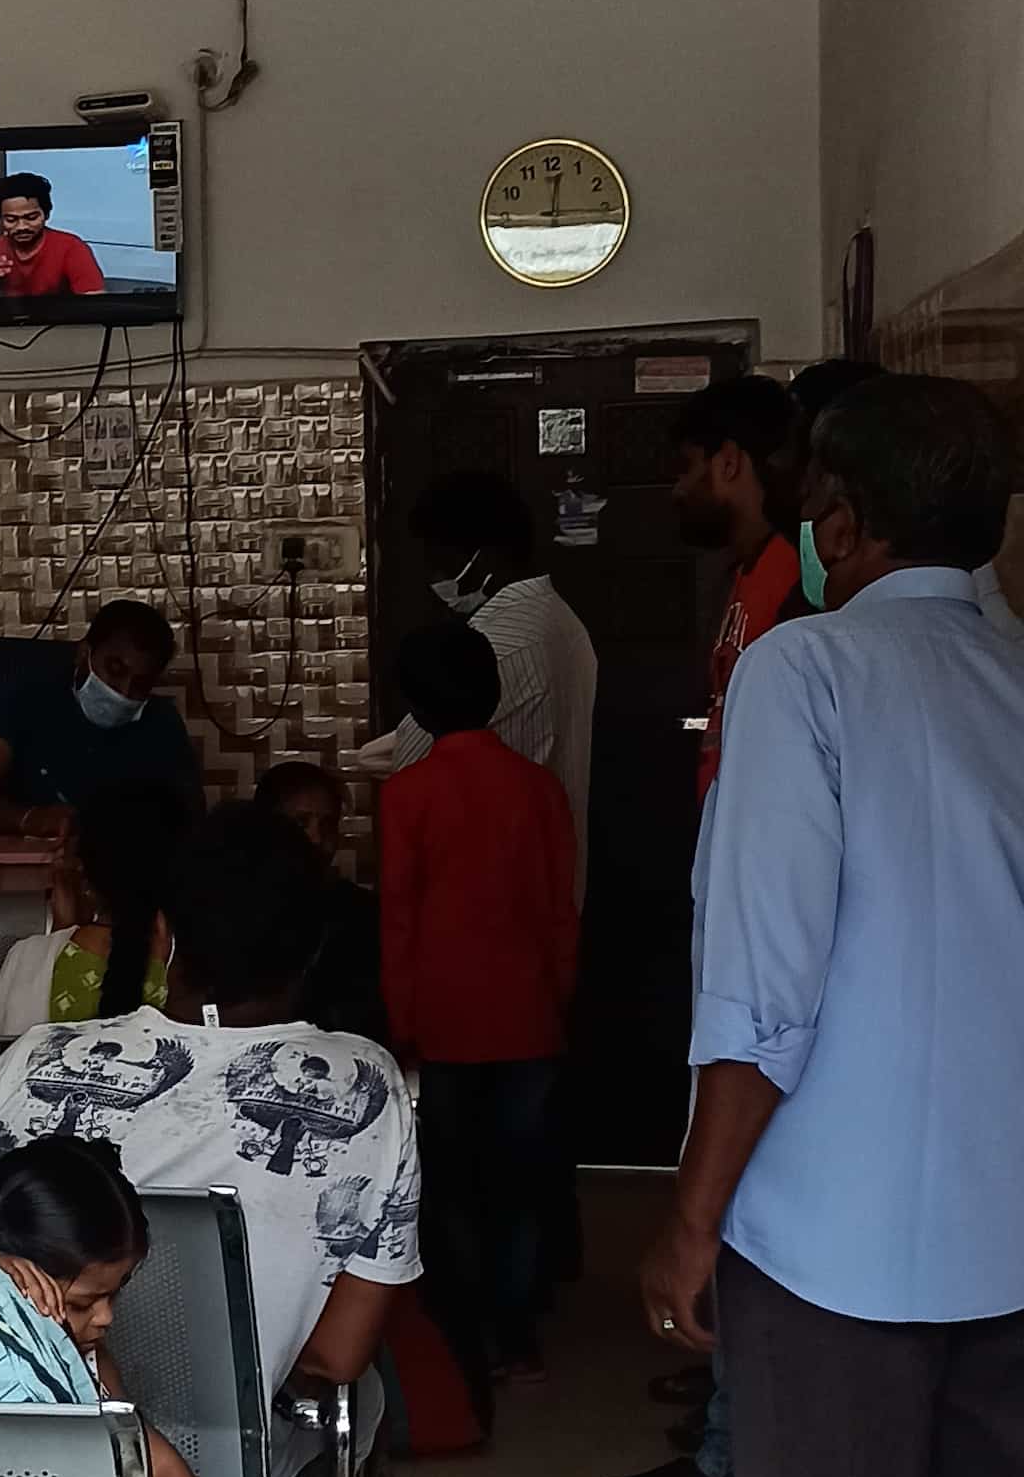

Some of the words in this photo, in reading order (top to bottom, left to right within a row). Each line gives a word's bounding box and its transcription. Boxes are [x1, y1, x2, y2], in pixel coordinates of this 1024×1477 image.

[543, 157, 560, 171] 12
[574, 161, 582, 175] 1
[520, 167, 535, 180] 11
[592, 178, 602, 191] 2
[503, 187, 519, 200] 10
